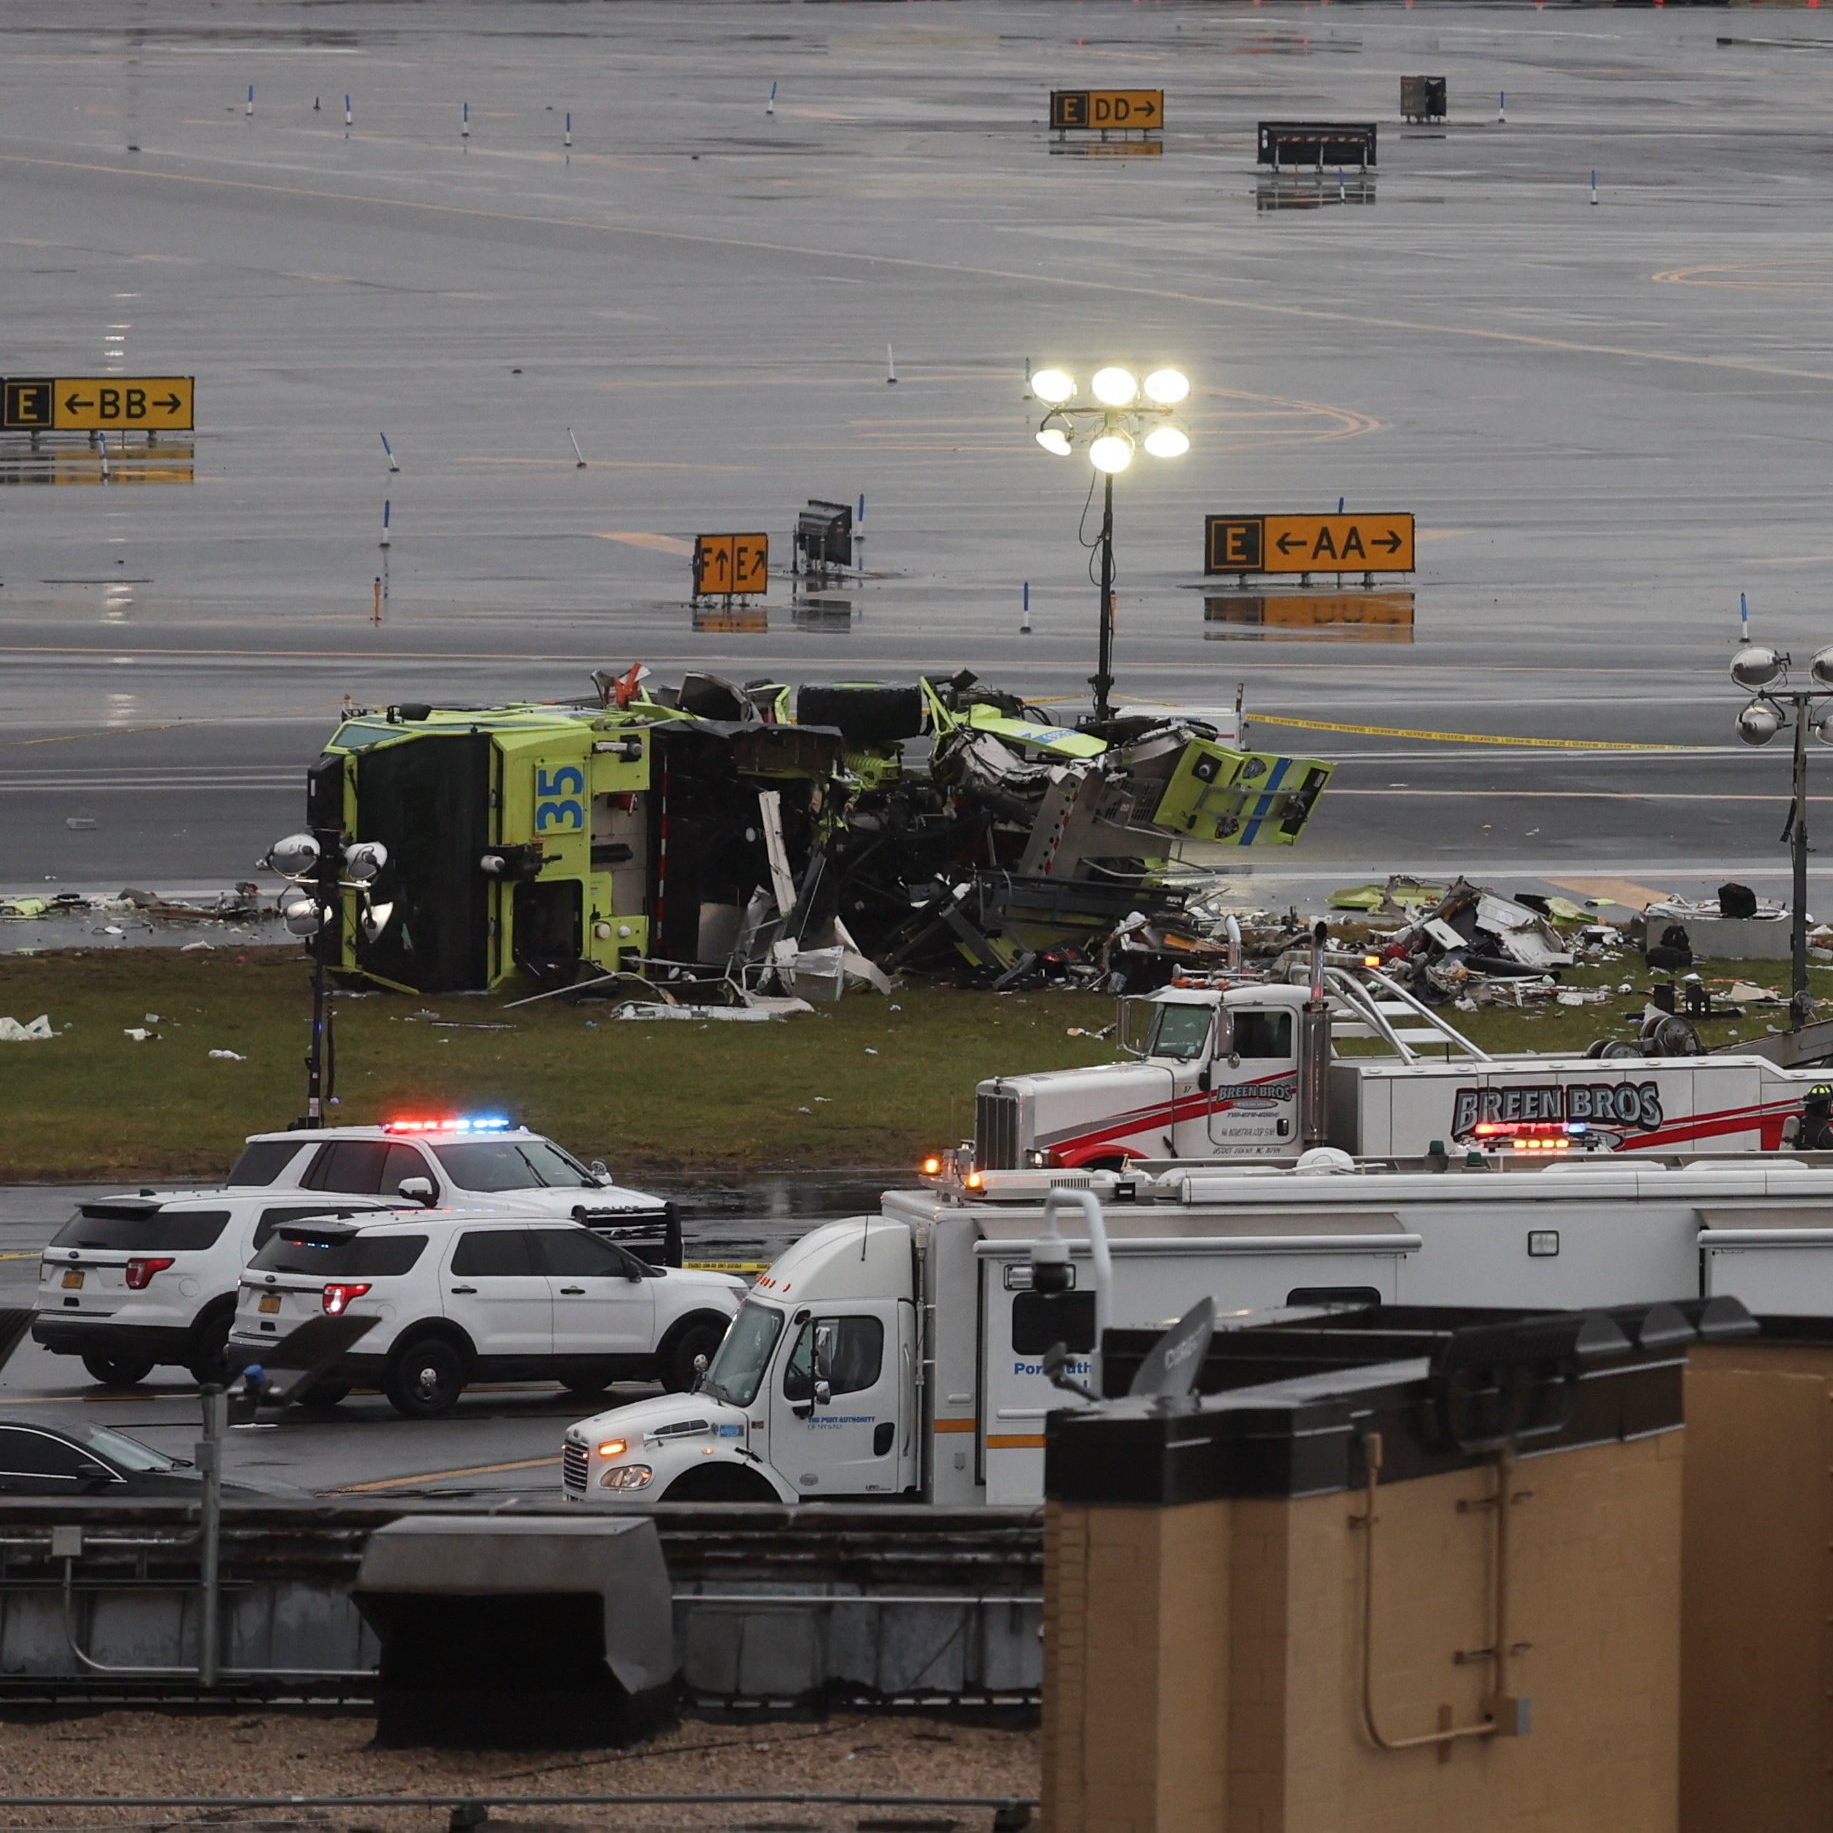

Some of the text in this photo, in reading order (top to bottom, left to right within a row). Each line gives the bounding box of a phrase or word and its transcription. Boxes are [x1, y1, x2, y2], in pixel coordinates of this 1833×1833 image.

[1062, 98, 1130, 122] E DD
[18, 388, 147, 420] E BB
[1226, 526, 1367, 561] E AA
[700, 547, 748, 582] F E
[536, 766, 584, 831] 35
[1217, 1084, 1293, 1102] BREEN BROS
[1451, 1081, 1664, 1143] BREEN BROS
[1014, 1362, 1044, 1375] Por
